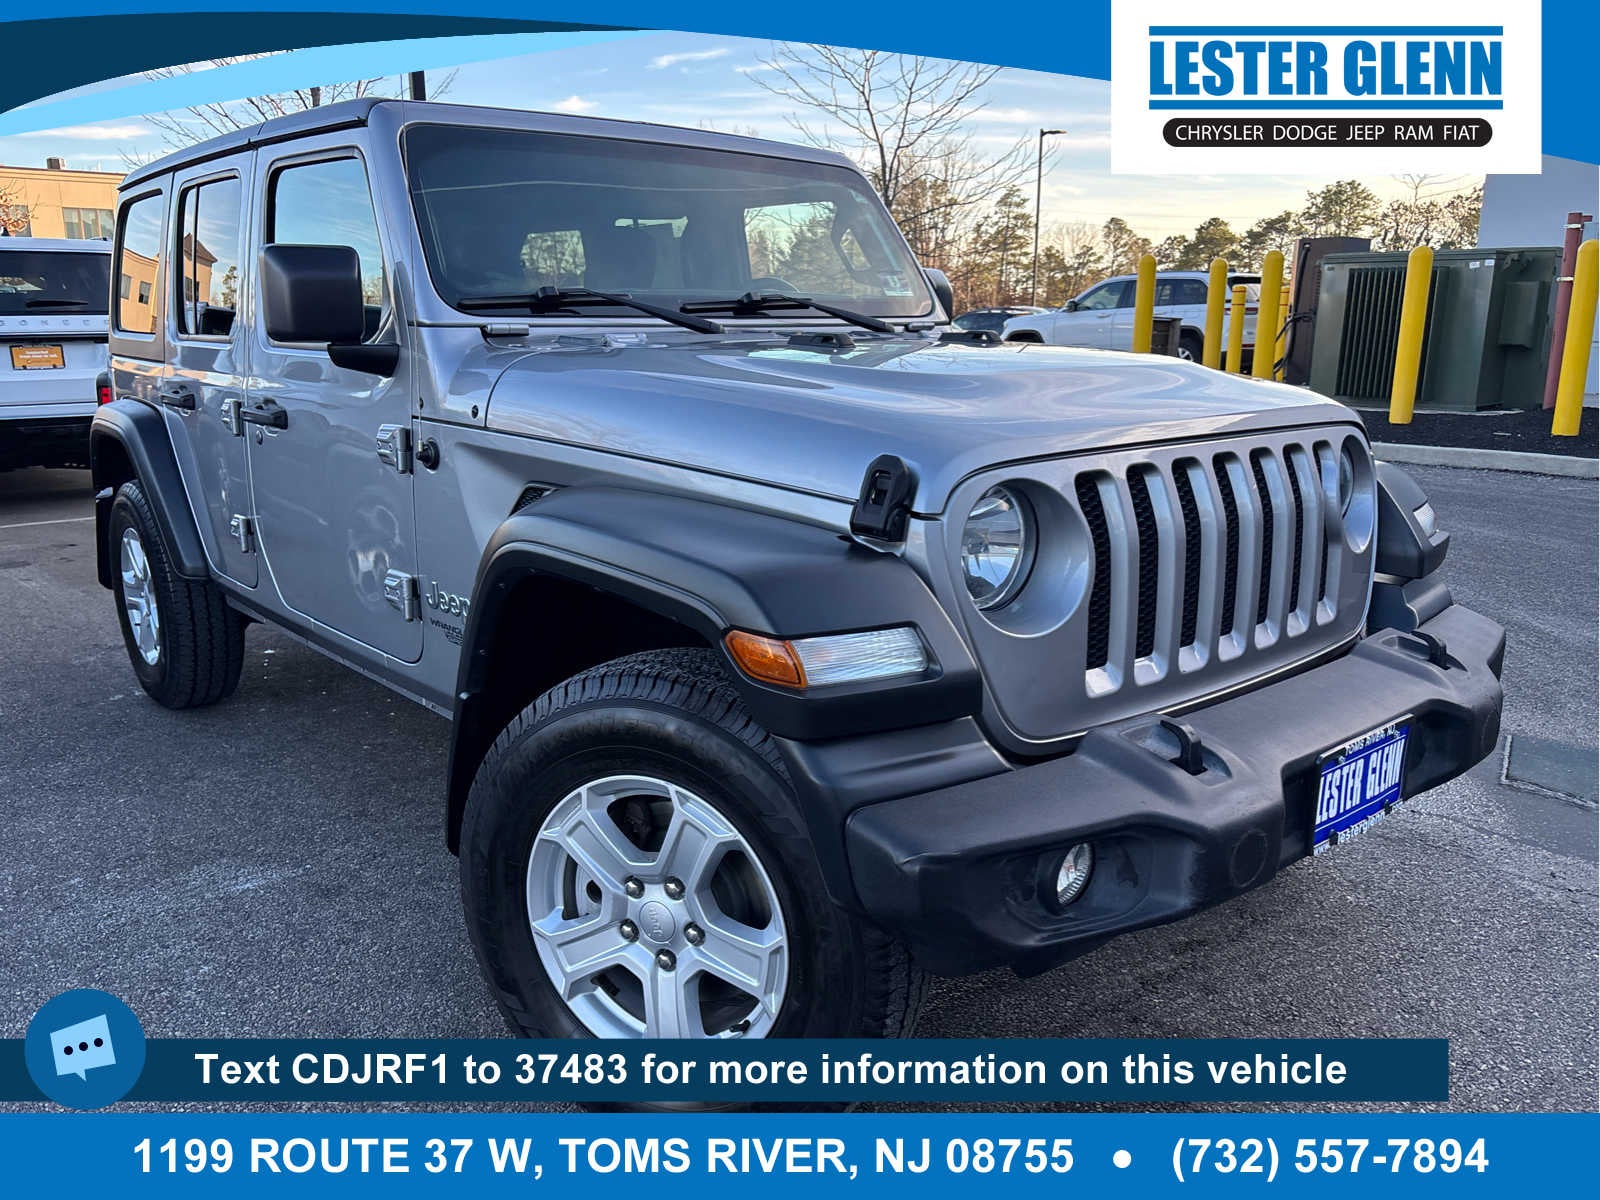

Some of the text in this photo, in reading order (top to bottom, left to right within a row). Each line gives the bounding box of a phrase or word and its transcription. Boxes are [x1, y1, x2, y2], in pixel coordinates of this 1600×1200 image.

[425, 581, 470, 624] Jeep
[1315, 738, 1405, 825] LESTER GLENN
